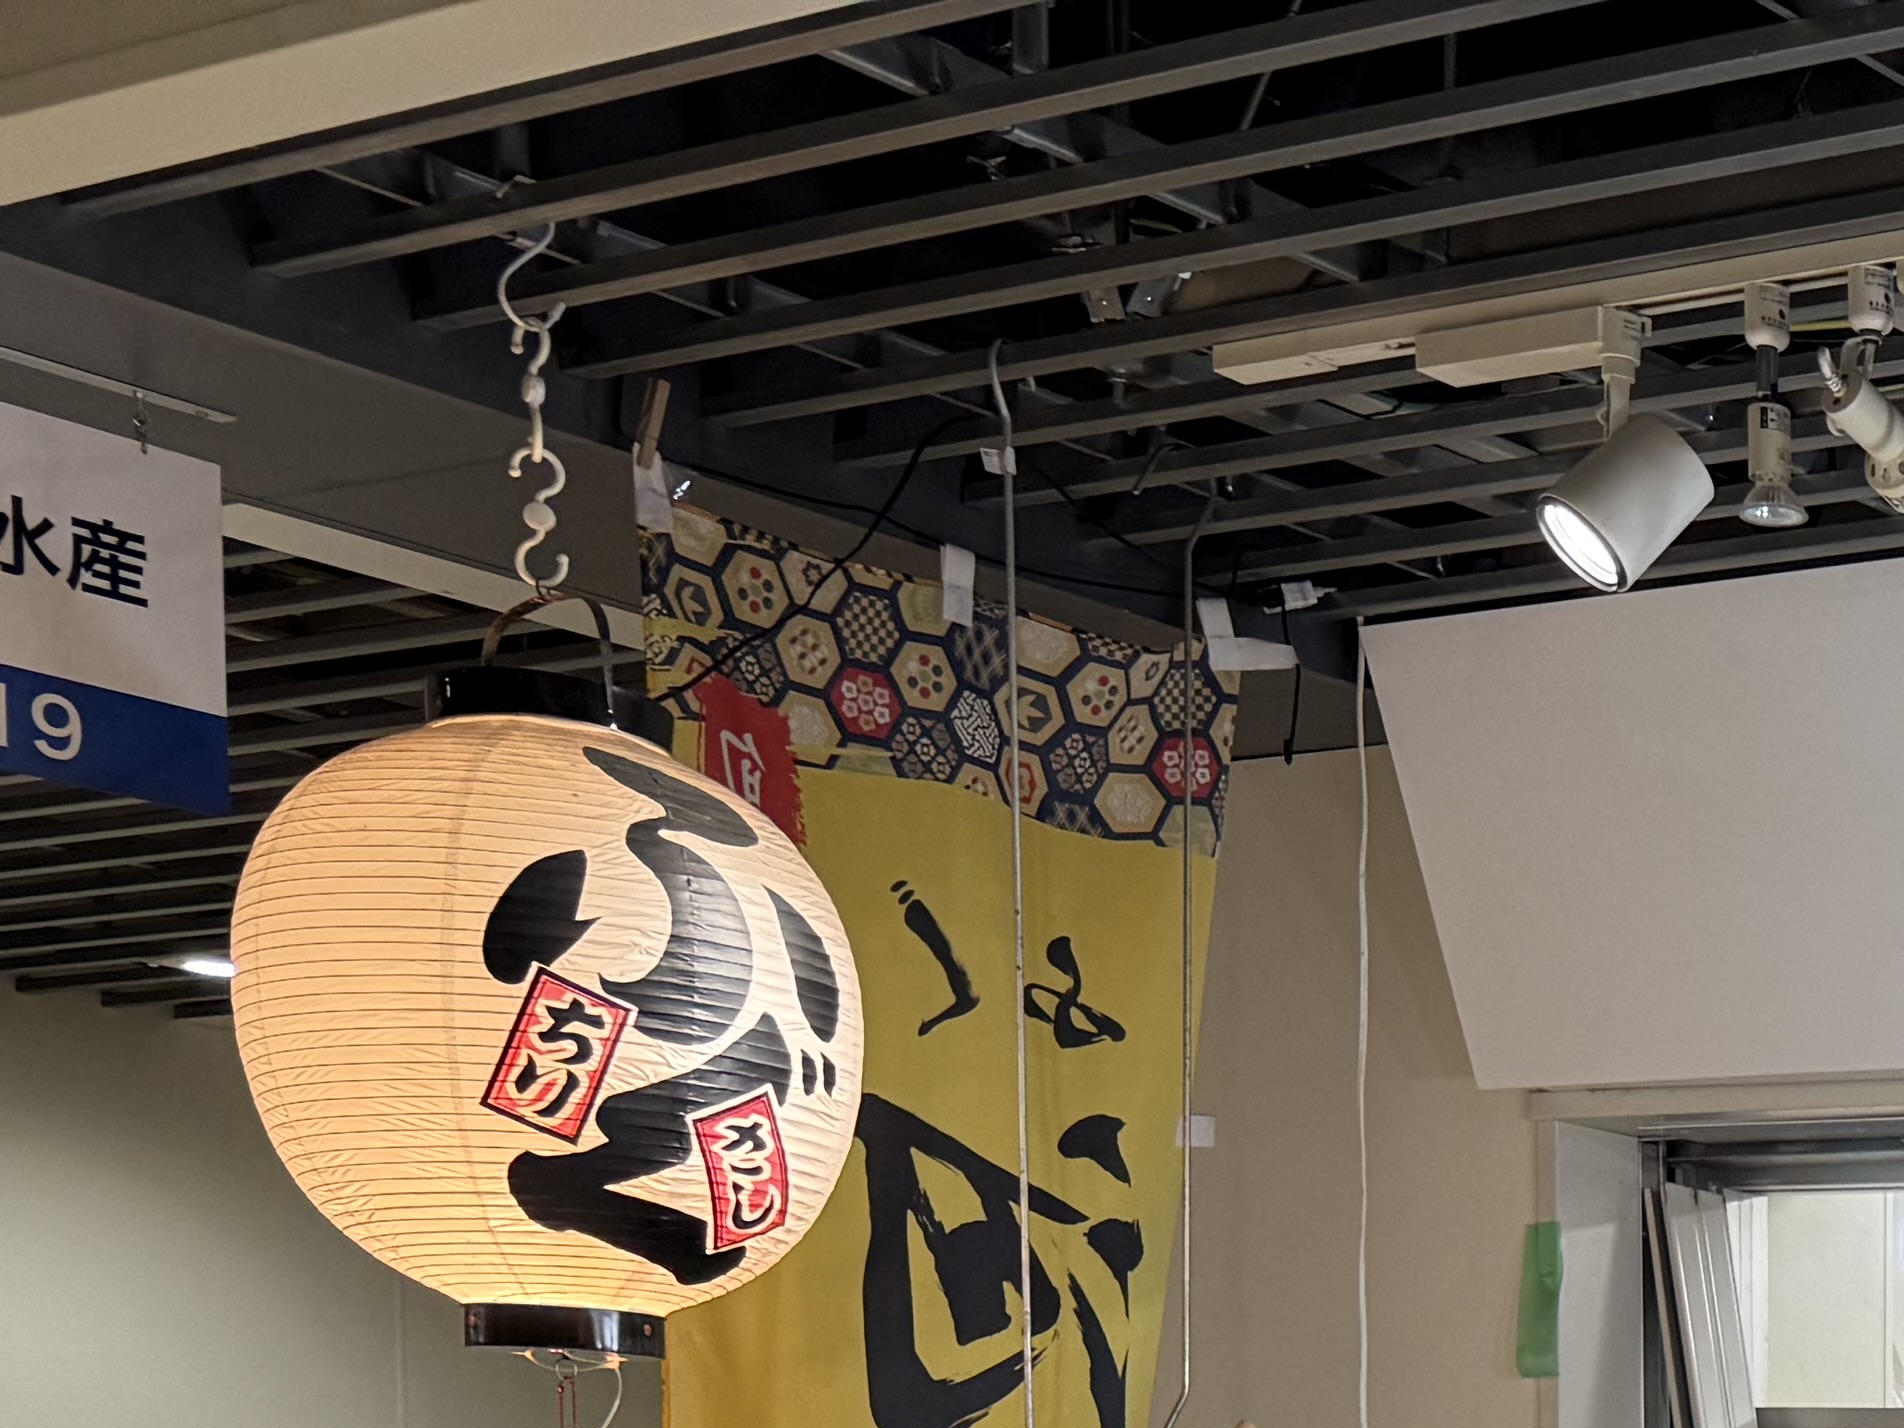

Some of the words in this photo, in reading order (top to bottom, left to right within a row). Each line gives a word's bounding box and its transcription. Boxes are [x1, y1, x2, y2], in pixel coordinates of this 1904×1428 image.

[0, 495, 148, 608] 水産
[482, 746, 841, 1286] ふぐ
[512, 998, 606, 1118] ちり
